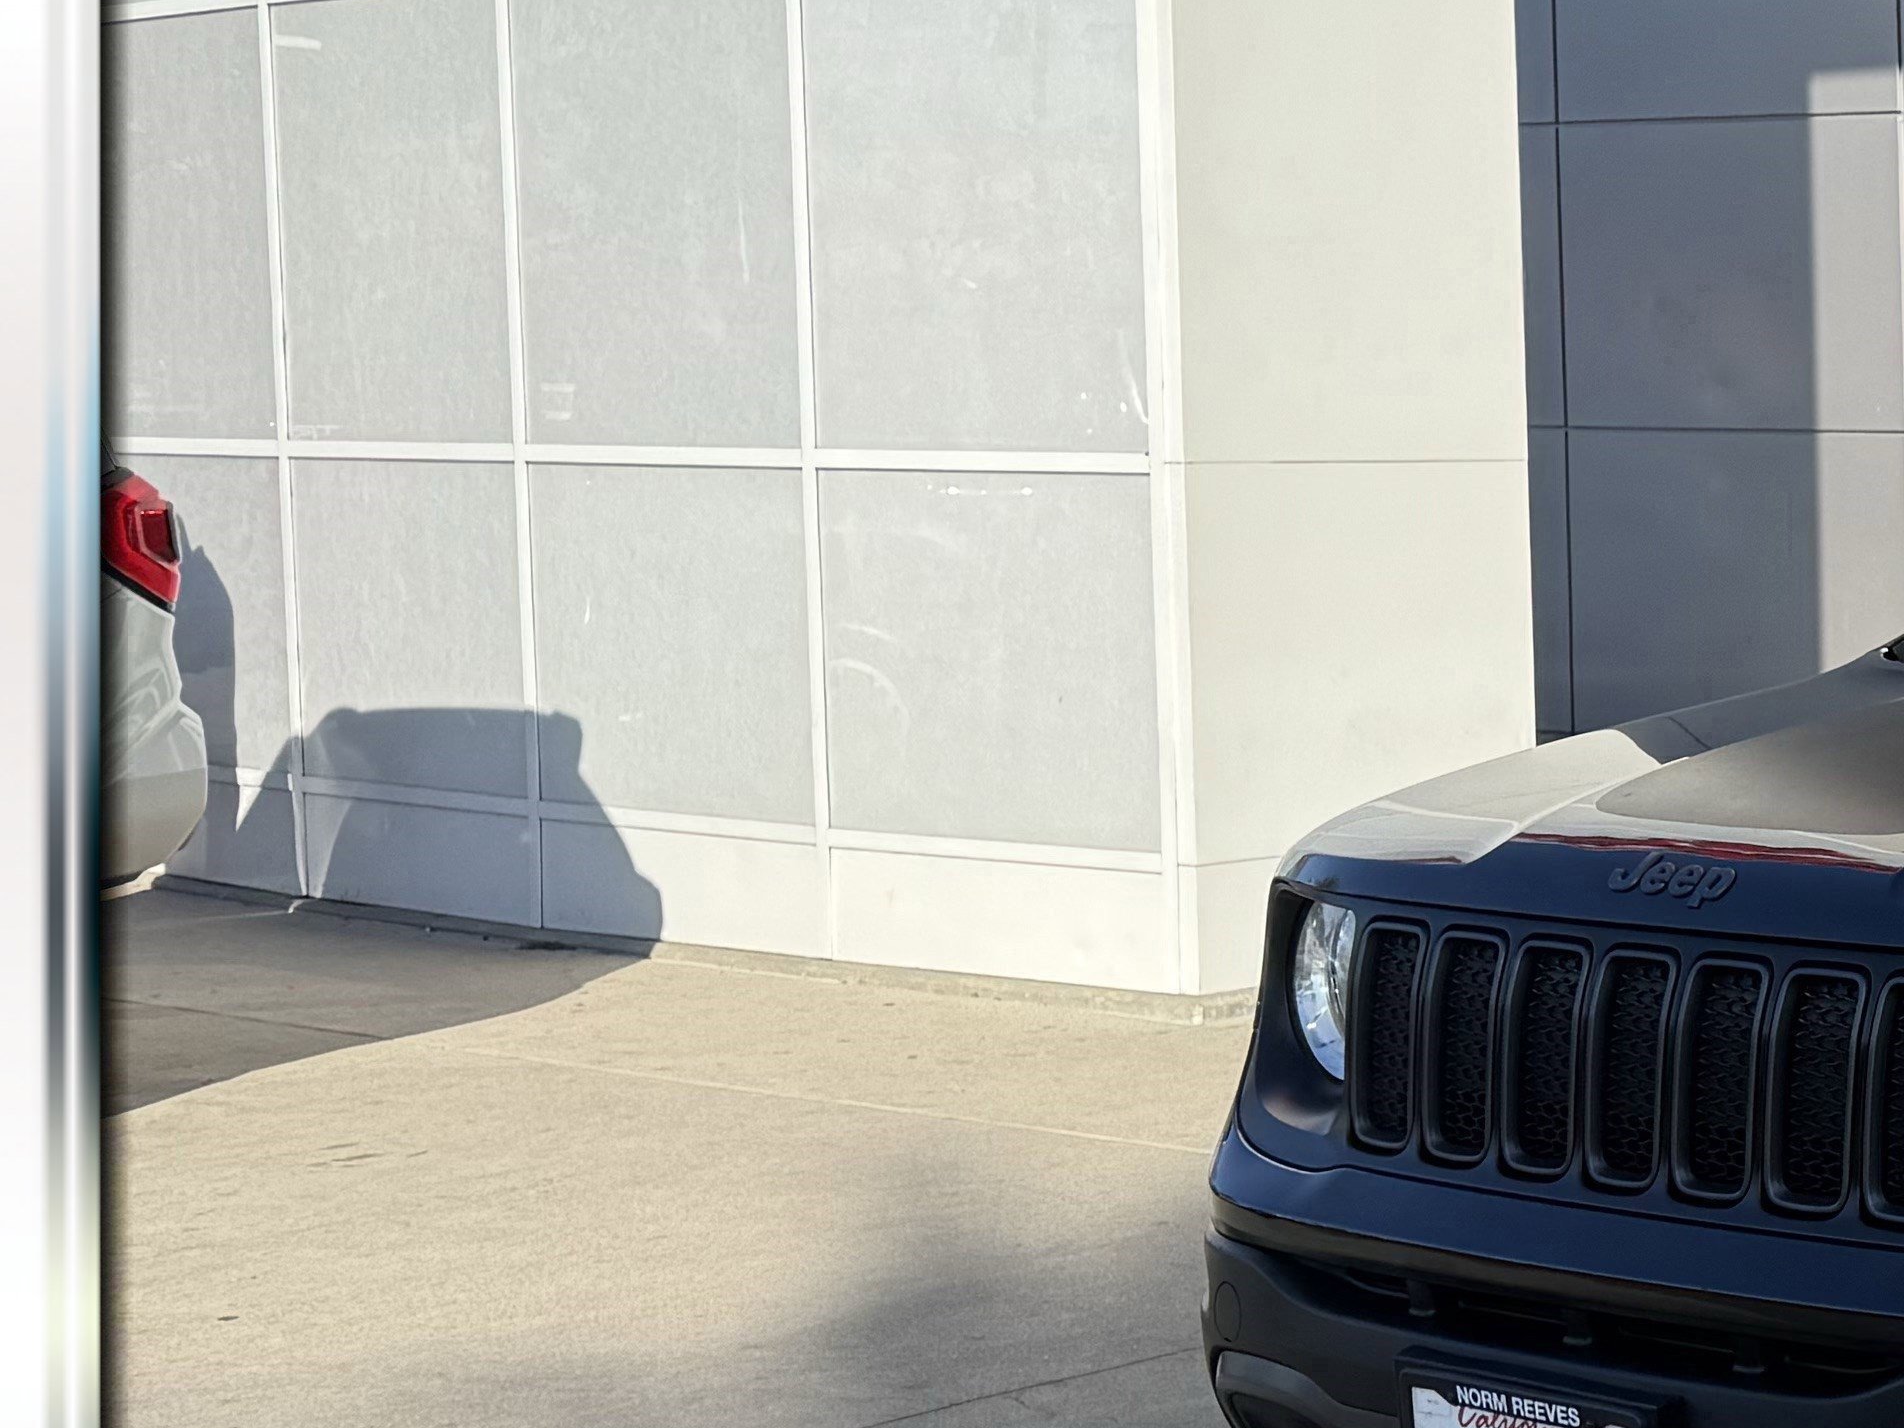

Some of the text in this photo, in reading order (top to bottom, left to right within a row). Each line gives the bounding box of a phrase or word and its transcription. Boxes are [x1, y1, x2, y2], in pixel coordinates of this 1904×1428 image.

[1607, 850, 1738, 910] Jeep
[1455, 1385, 1581, 1427] NORM REEVES
